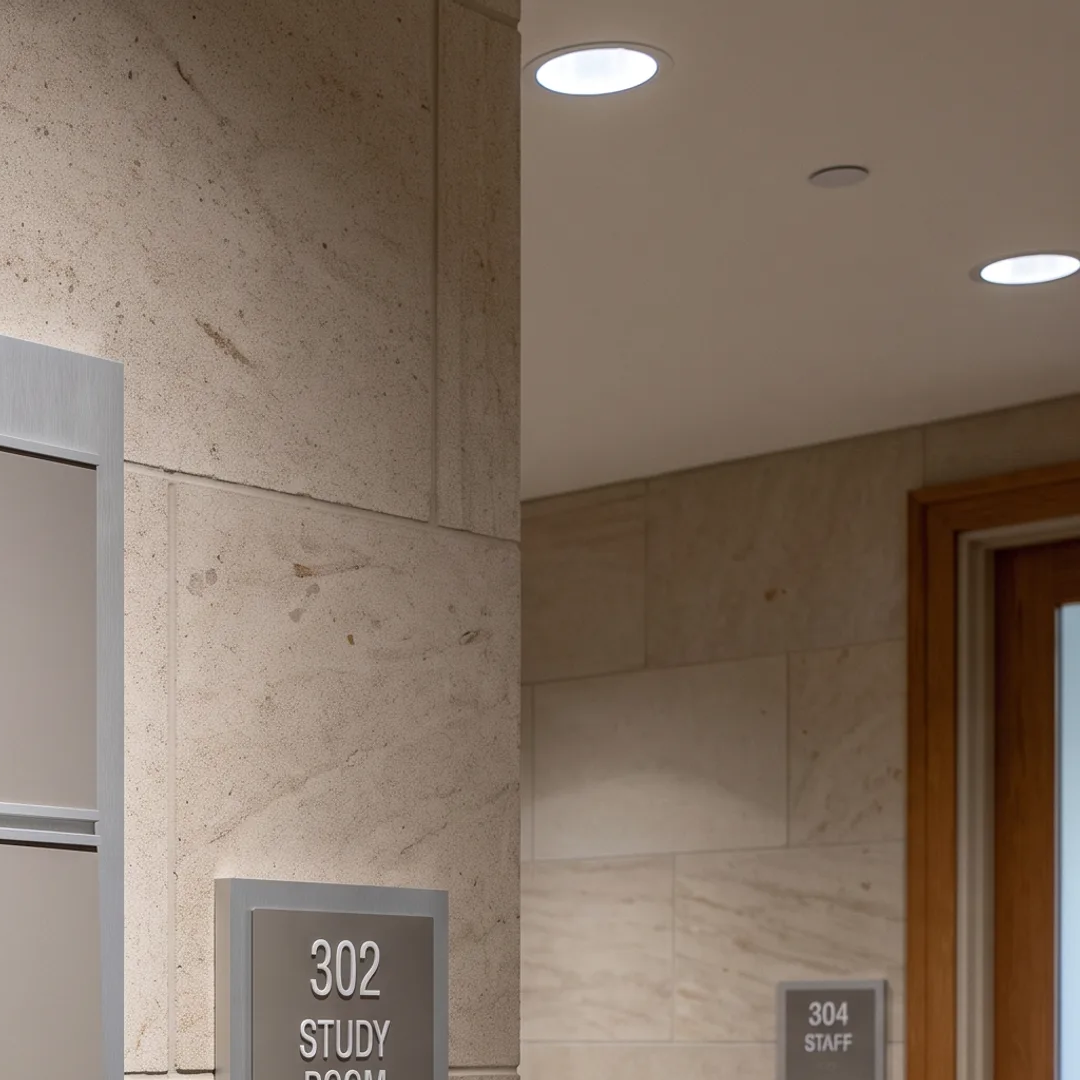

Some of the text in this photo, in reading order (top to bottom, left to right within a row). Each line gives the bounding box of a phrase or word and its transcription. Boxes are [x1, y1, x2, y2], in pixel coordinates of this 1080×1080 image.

[310, 938, 381, 997] 302
[808, 1001, 849, 1027] 304
[299, 1018, 391, 1059] STUDY
[804, 1033, 853, 1052] STAFF
